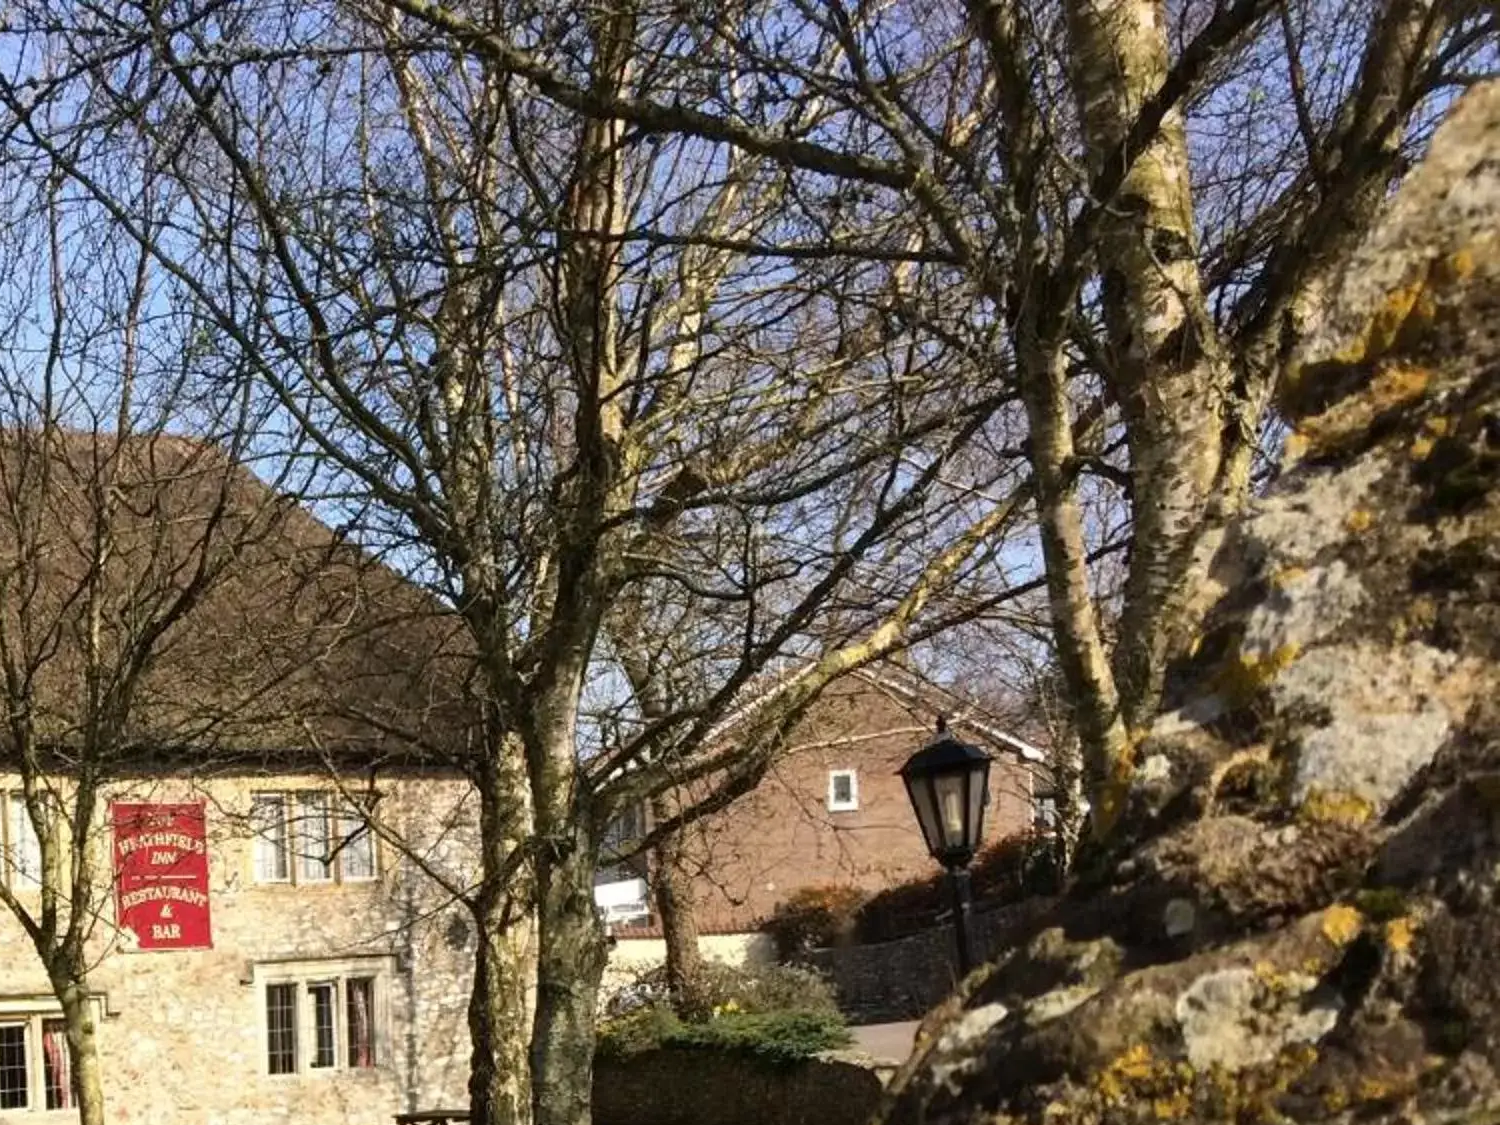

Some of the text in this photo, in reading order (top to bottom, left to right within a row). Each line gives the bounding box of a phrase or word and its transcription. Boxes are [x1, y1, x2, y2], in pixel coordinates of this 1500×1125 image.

[117, 831, 205, 857] HEATHFIELD
[150, 851, 179, 865] INN
[121, 886, 208, 910] RESTAURANT
[159, 904, 173, 919] &
[151, 924, 181, 940] BAR
